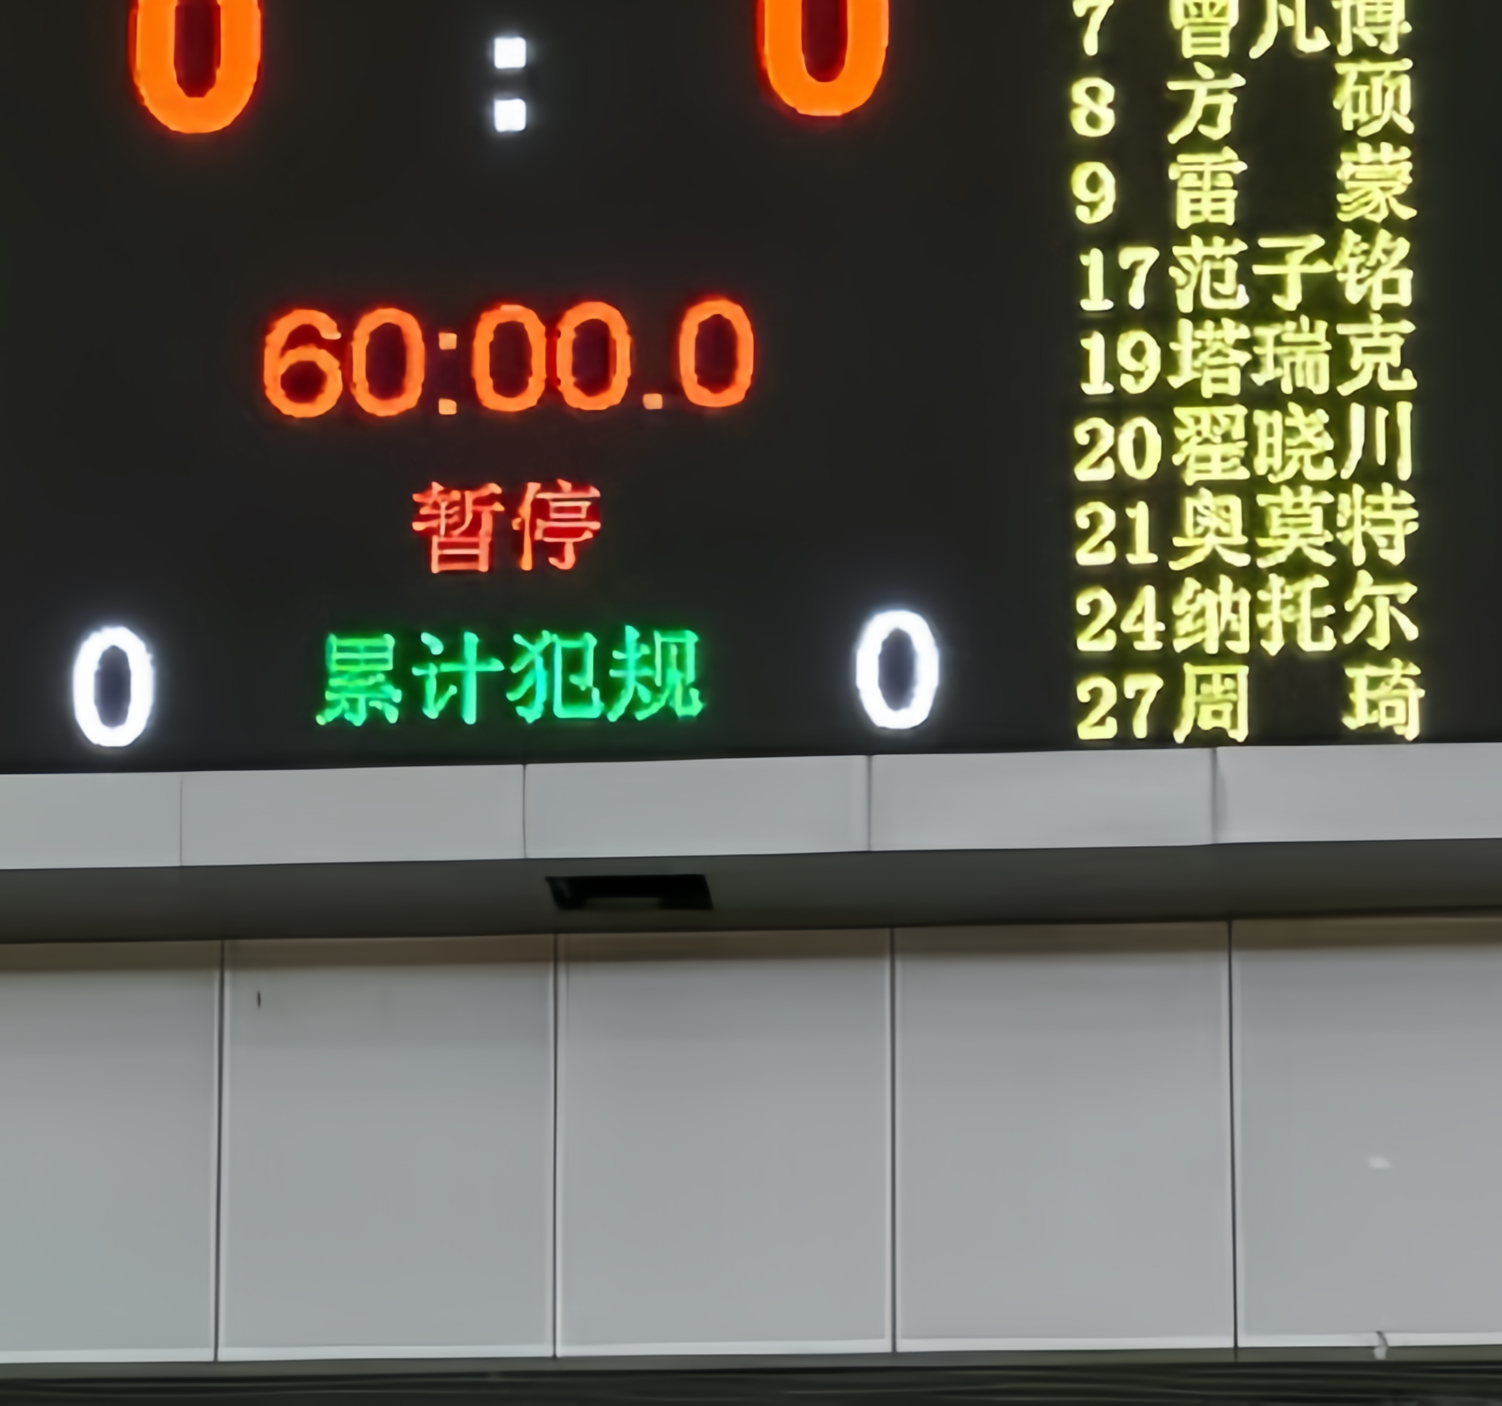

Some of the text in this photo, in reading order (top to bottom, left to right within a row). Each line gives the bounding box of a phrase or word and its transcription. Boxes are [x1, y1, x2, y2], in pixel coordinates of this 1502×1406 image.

[1070, 77, 1115, 137] 8
[1071, 162, 1116, 224] 9
[1080, 229, 1413, 313] 17 范子铭
[260, 294, 759, 420] 60:00.0
[1081, 313, 1417, 398] 19 塔瑞克
[1074, 401, 1412, 486] 20 翟晓川
[409, 478, 605, 574] 暂停
[1075, 482, 1419, 570] 21 奥莫特
[1076, 570, 1418, 656] 24 纳托尔
[70, 622, 158, 748] 0
[313, 624, 707, 727] 累计犯规
[853, 605, 942, 731] 0
[1077, 674, 1165, 739] 27
